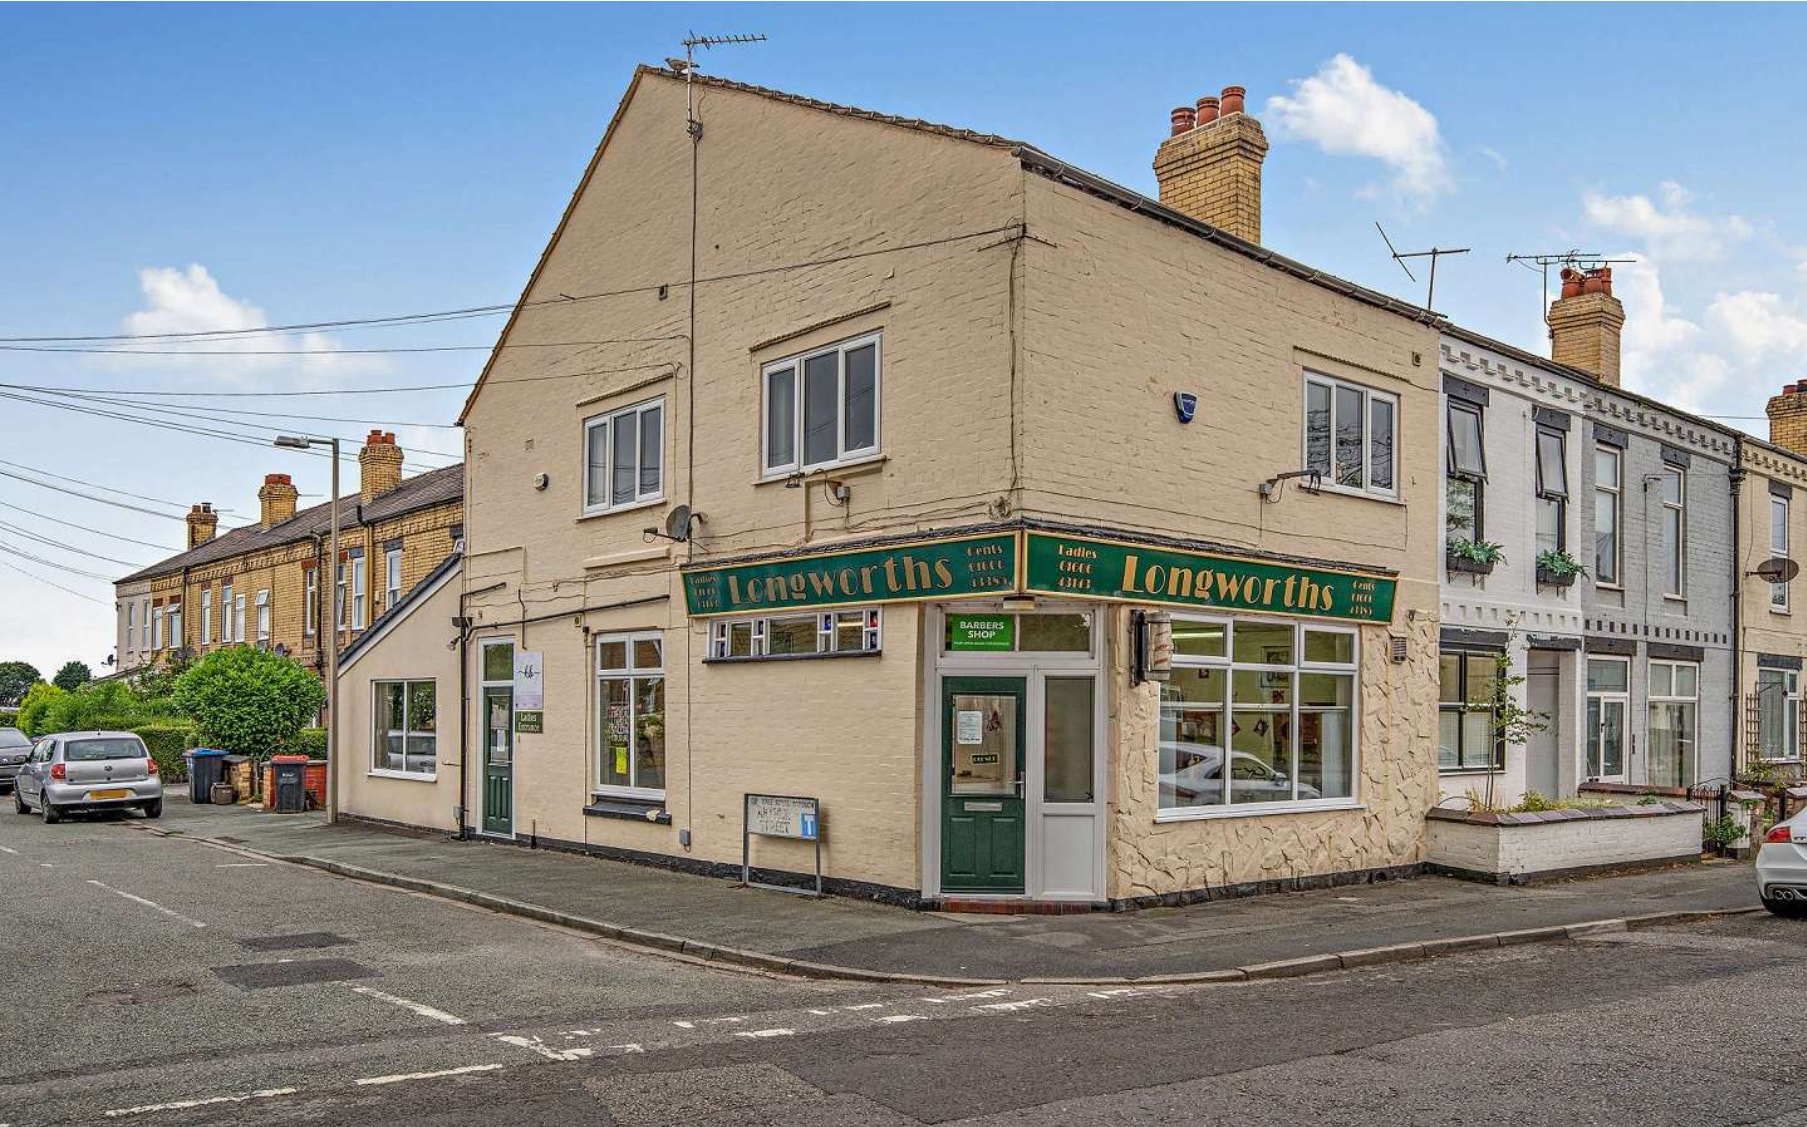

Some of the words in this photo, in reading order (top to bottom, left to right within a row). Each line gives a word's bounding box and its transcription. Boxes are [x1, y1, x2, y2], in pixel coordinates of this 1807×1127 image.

[966, 544, 1003, 556] Gents
[1058, 544, 1097, 559] Ladies
[728, 555, 954, 606] Longworths
[1122, 555, 1334, 611] Longworths
[959, 621, 1005, 629] BARBERS
[967, 630, 996, 639] SHOP
